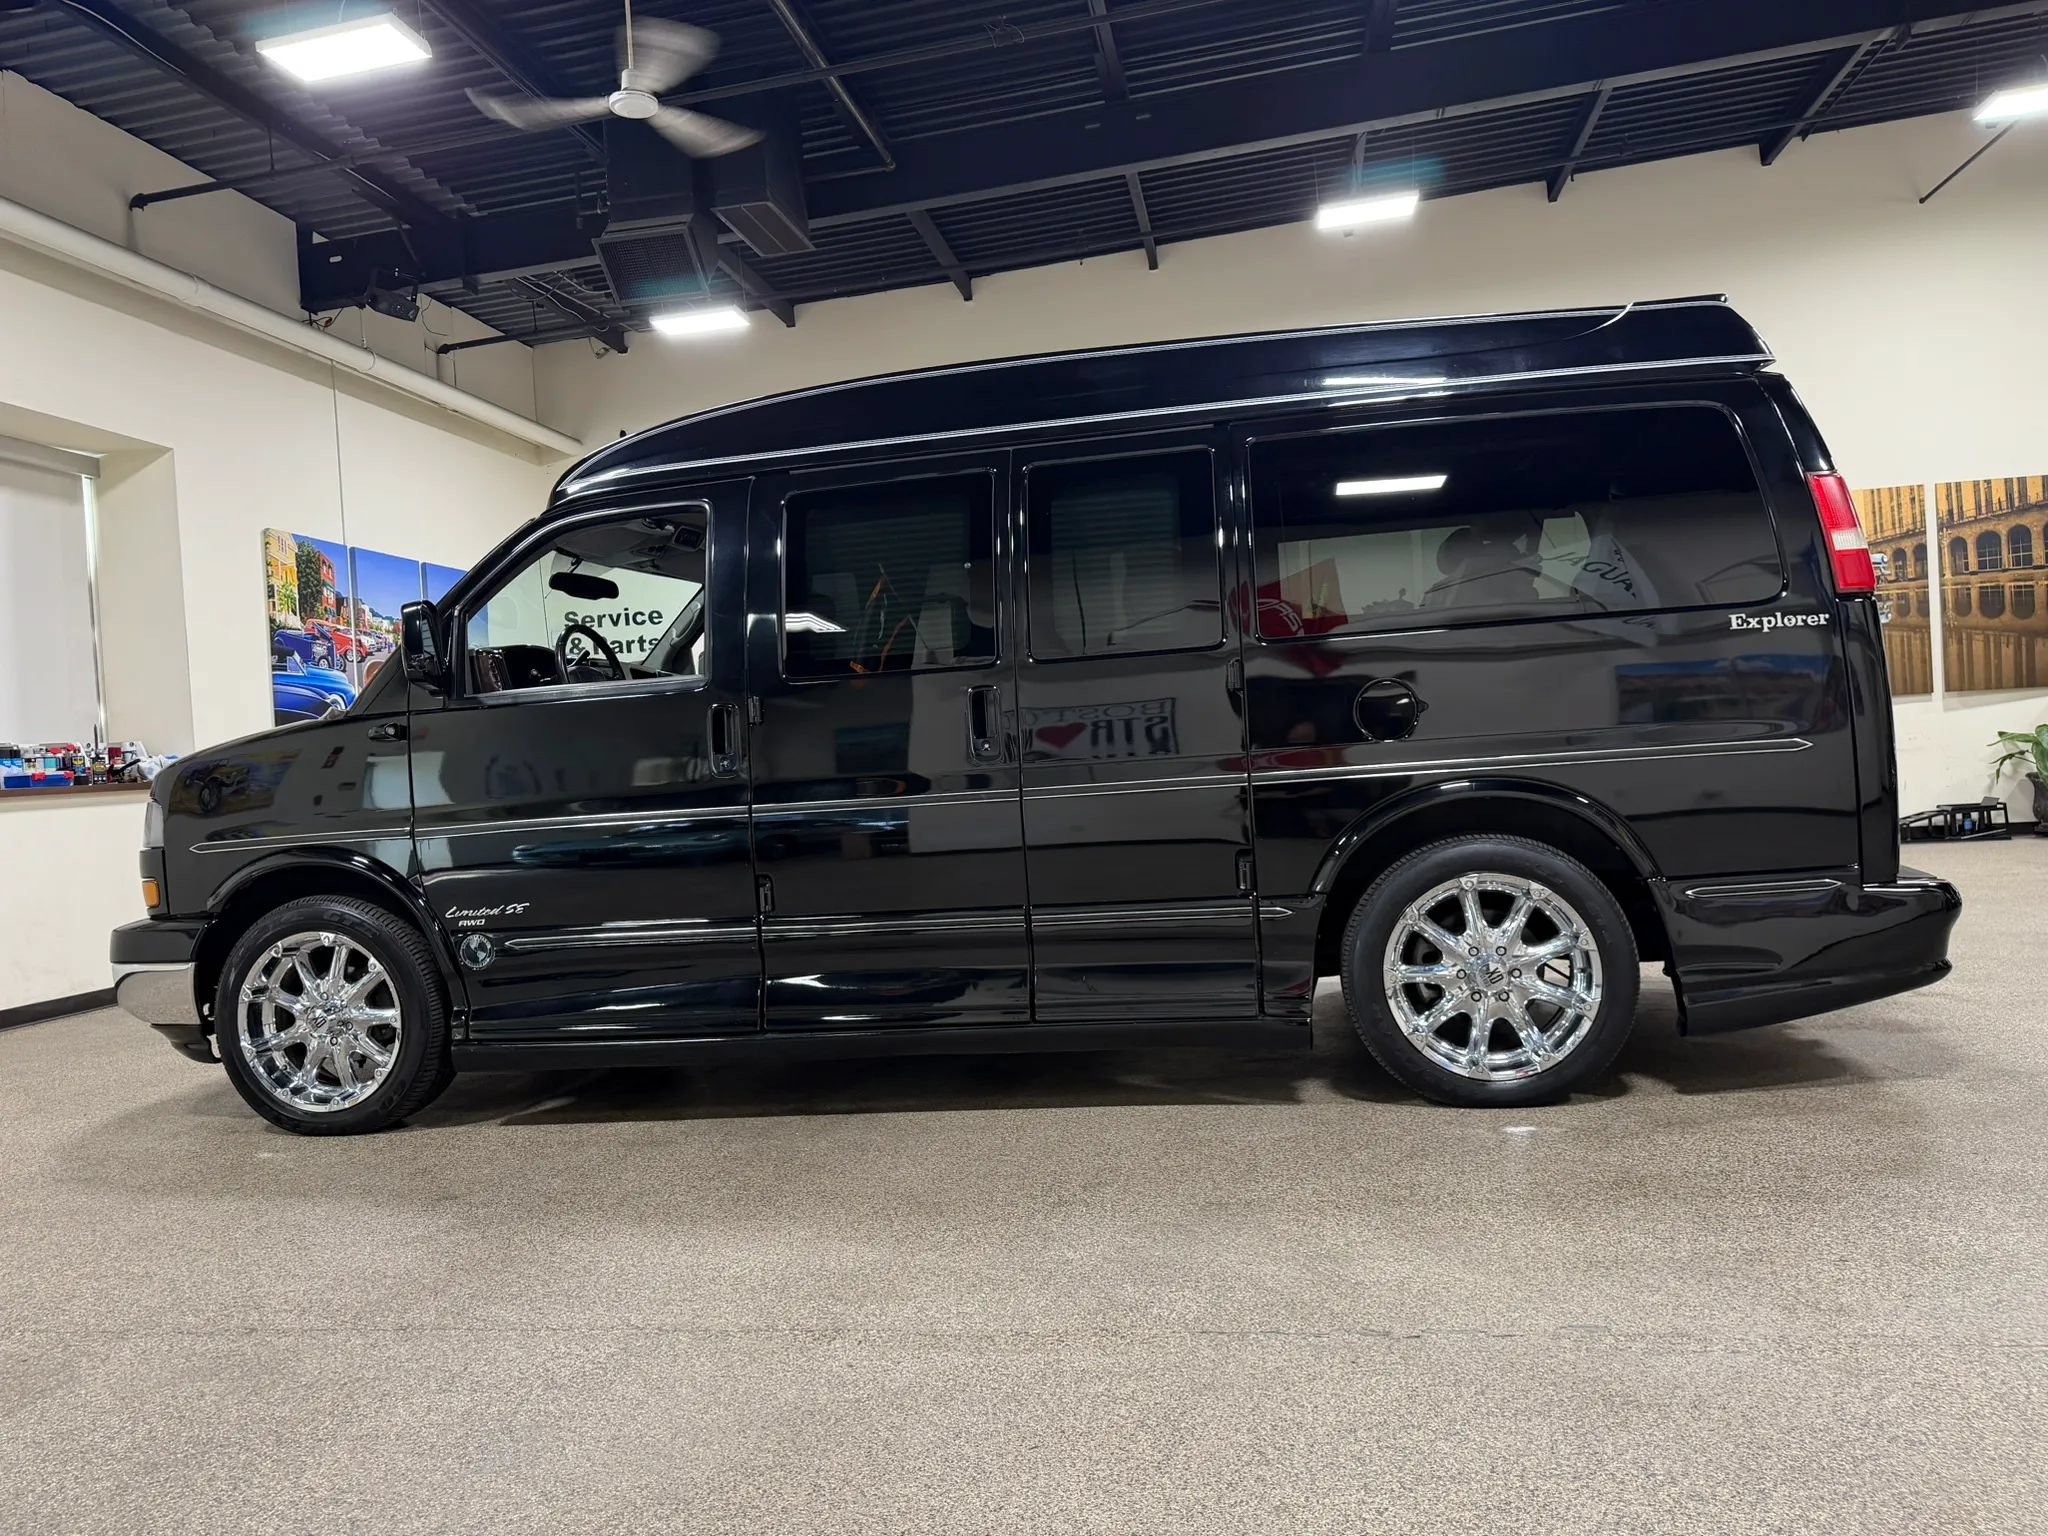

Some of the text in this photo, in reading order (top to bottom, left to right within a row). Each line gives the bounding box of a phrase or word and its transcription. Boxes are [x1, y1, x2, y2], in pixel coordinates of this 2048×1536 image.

[564, 607, 664, 629] Service
[1728, 612, 1830, 632] Explorer
[569, 637, 586, 655] &
[445, 902, 531, 919] Limited SE
[458, 918, 486, 928] AWD
[1485, 966, 1504, 985] XD
